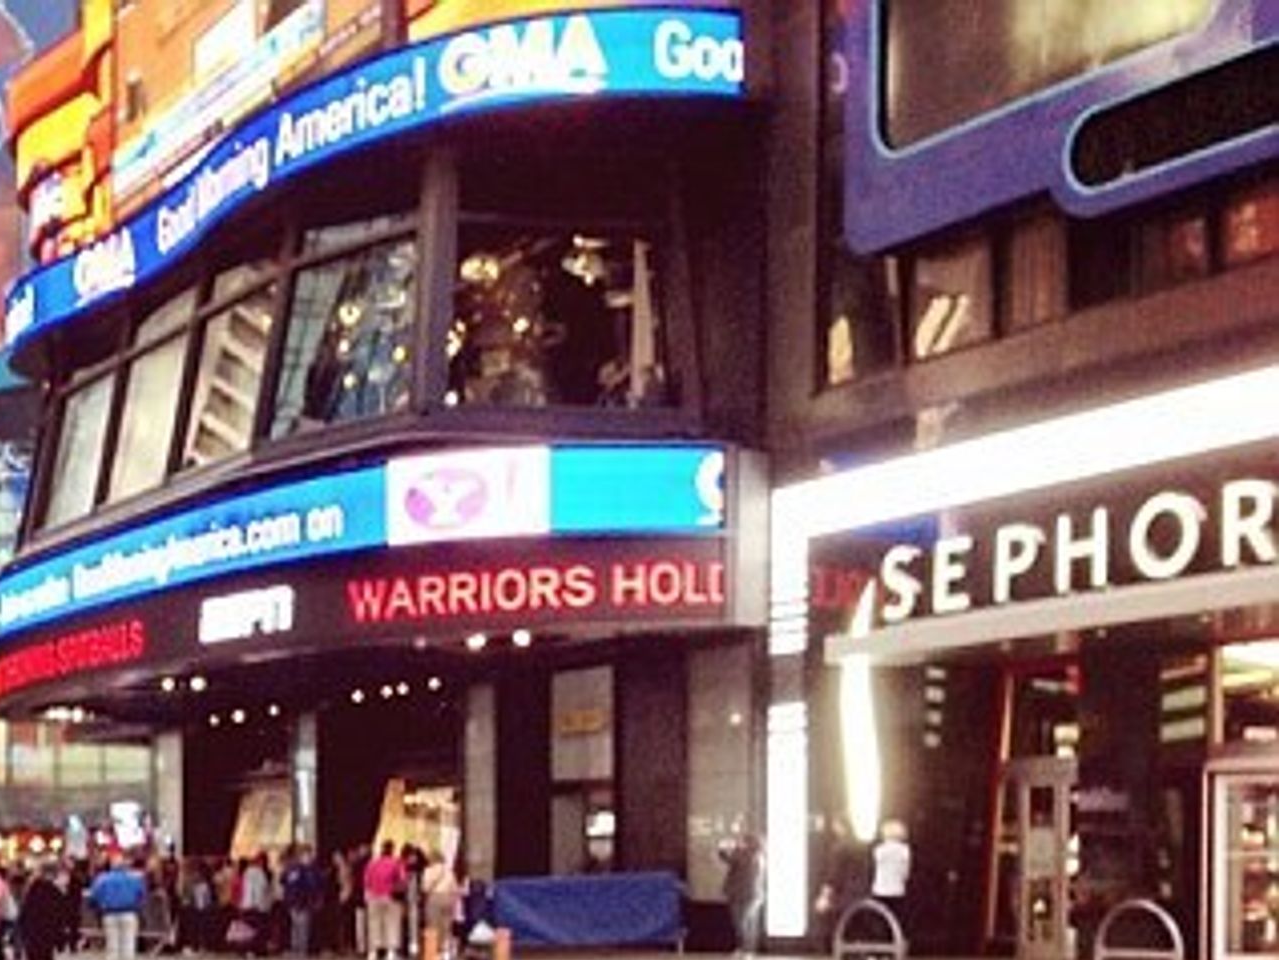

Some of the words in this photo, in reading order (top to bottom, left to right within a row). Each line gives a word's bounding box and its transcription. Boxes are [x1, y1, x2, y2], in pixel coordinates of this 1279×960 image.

[436, 13, 609, 96] GMA
[275, 57, 426, 166] America!
[347, 565, 595, 622] WARRIORS
[880, 479, 1279, 624] SEPHOR
